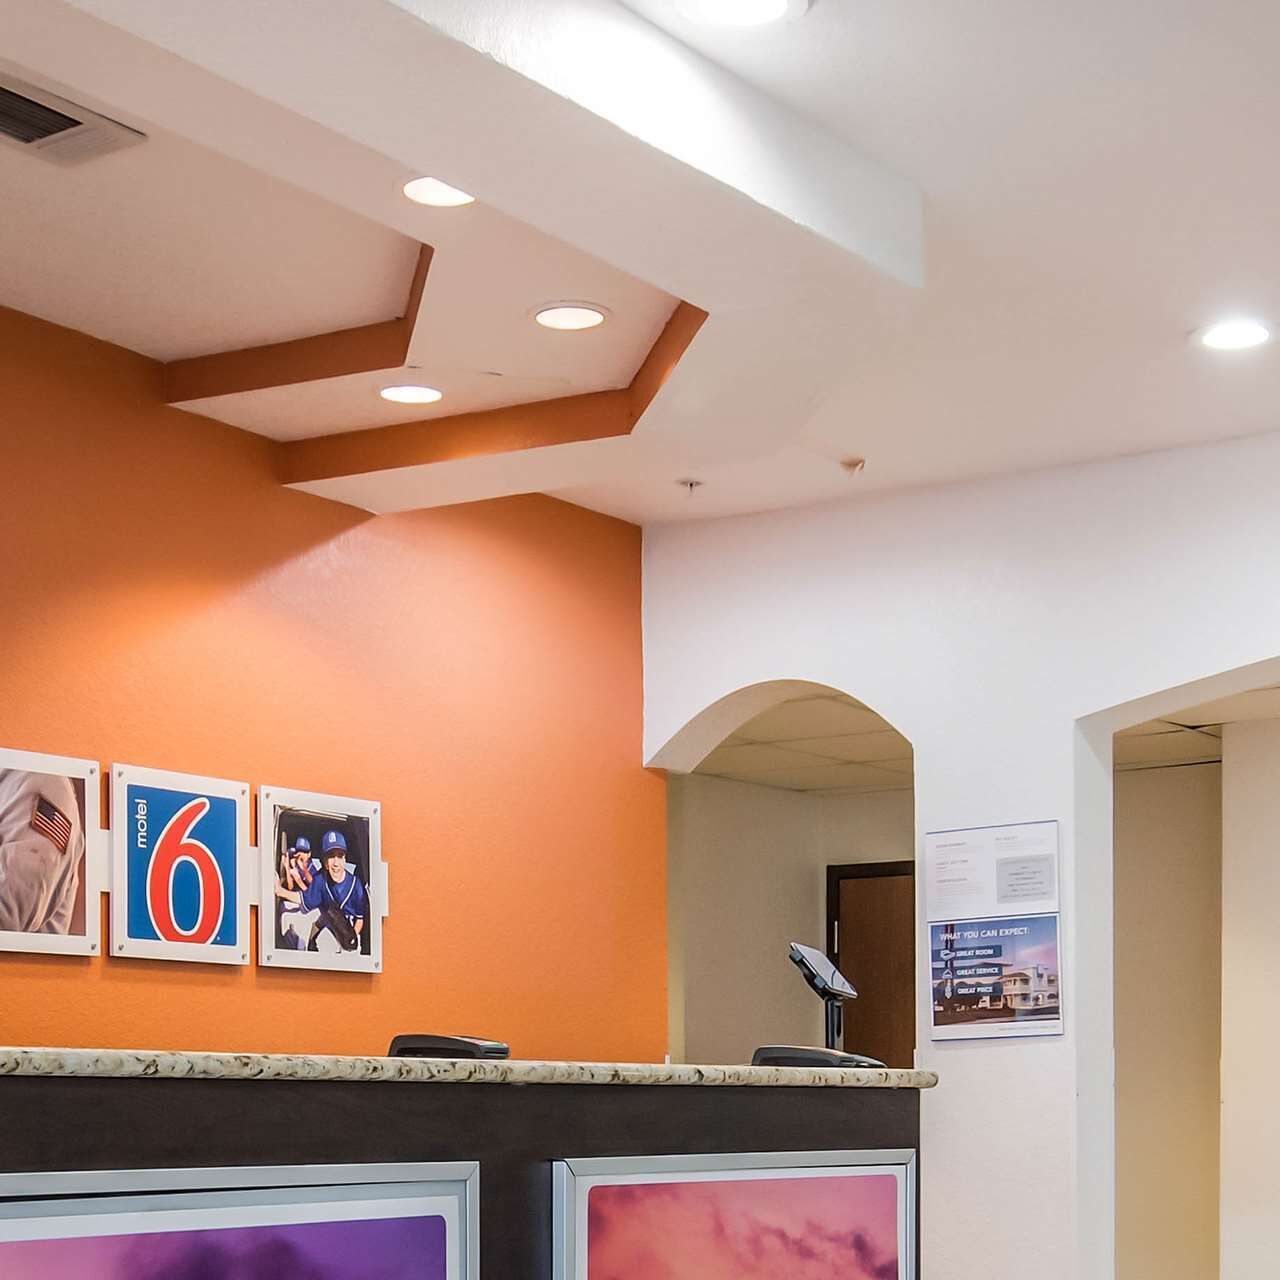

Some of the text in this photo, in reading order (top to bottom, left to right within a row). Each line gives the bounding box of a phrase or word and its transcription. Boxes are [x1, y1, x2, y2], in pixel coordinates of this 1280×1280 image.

[137, 797, 225, 945] motel 6
[940, 932, 961, 940] WHAT
[964, 930, 979, 938] YOU
[981, 929, 997, 937] CAN
